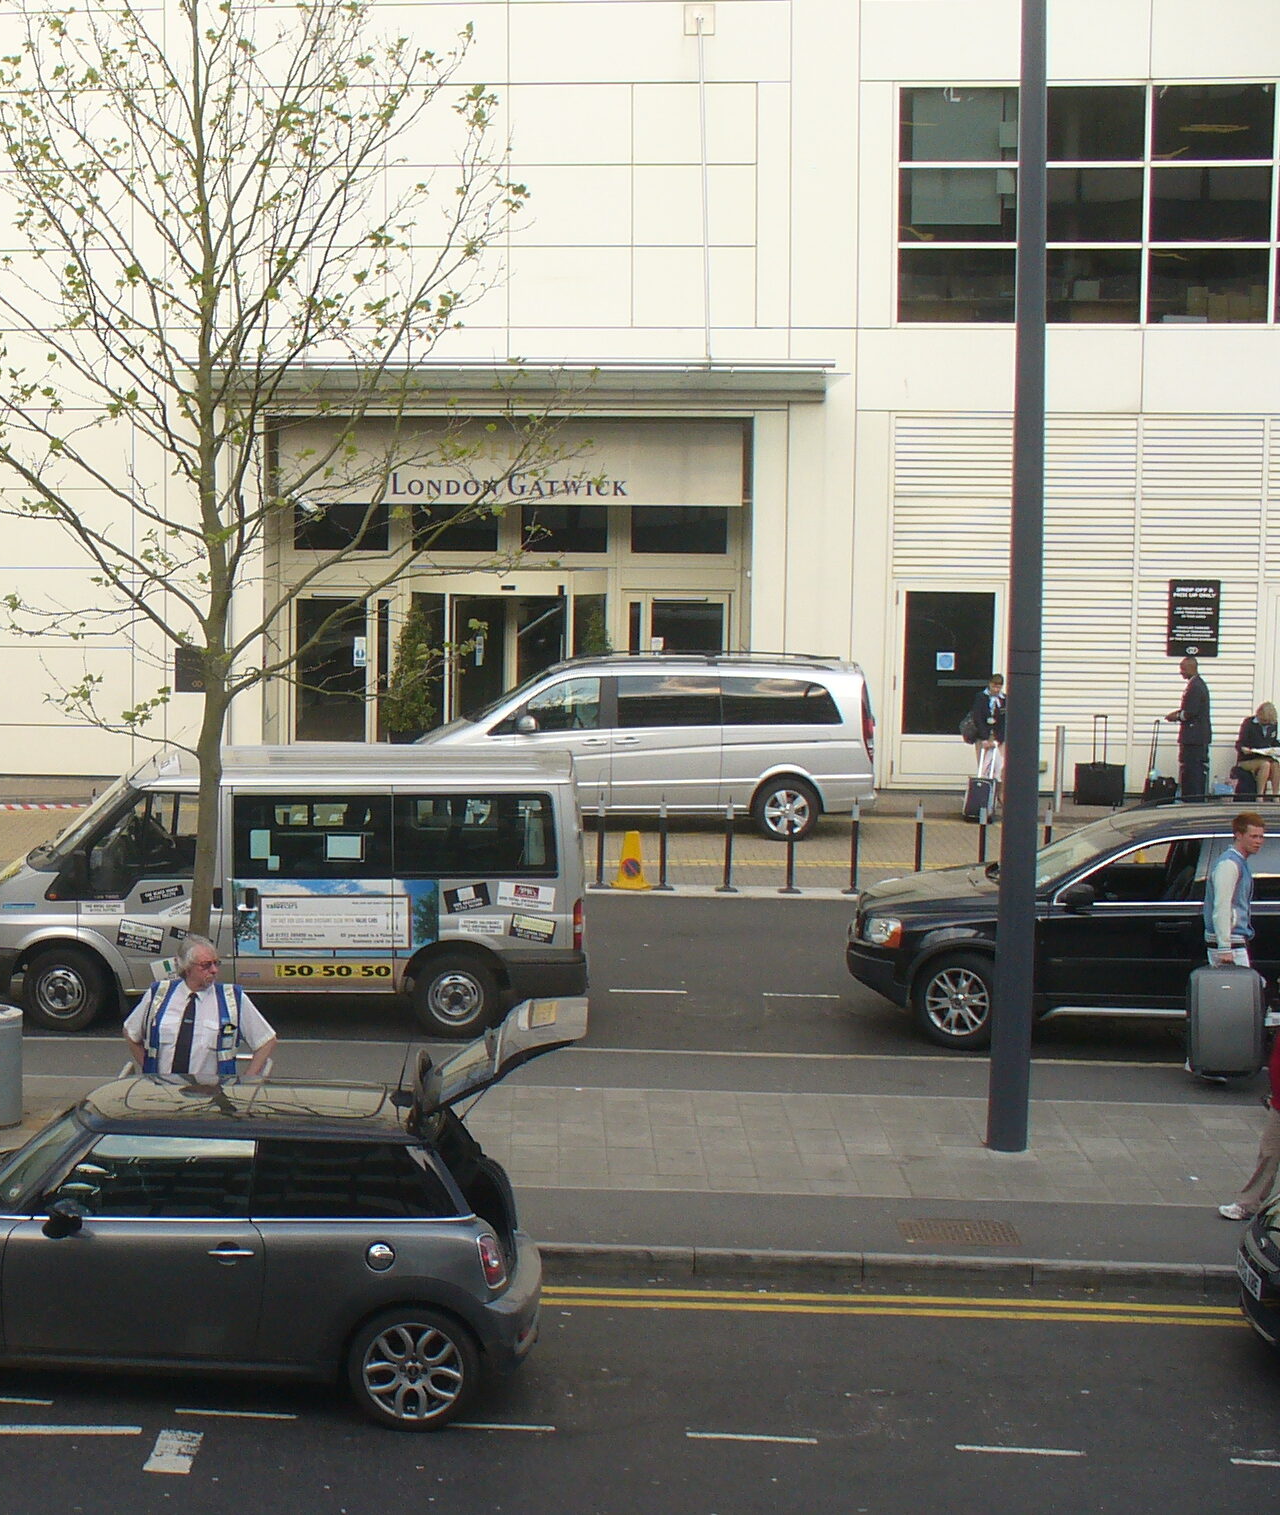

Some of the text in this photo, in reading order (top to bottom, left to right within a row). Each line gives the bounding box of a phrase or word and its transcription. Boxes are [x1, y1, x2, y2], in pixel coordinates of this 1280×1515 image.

[392, 472, 628, 496] LONDON GATWICK
[284, 965, 313, 977] 50
[323, 965, 352, 977] 50
[361, 965, 391, 977] 50
